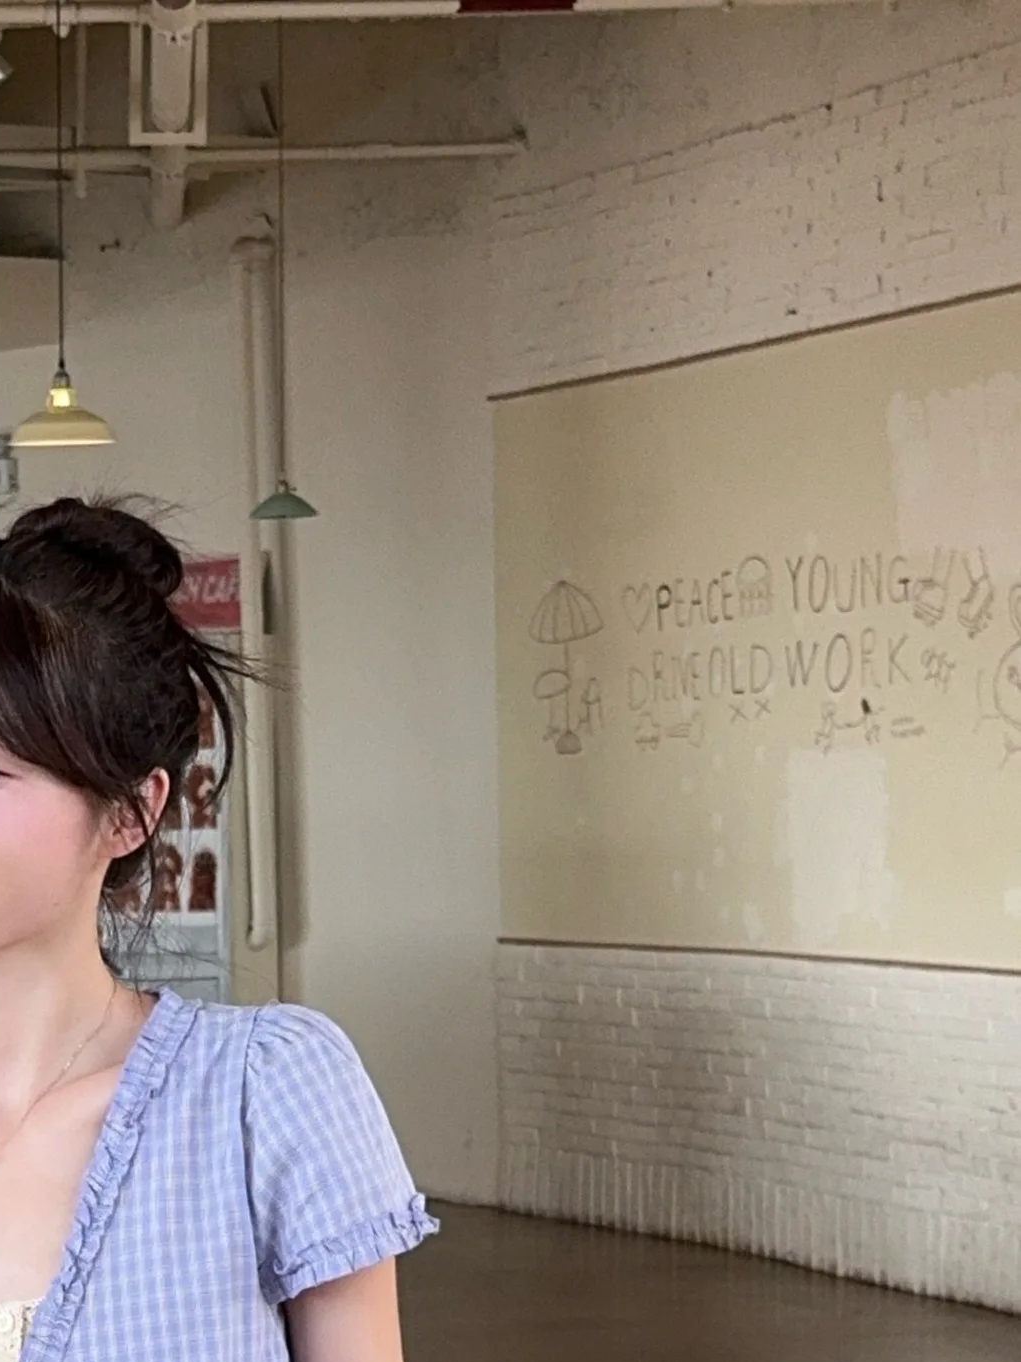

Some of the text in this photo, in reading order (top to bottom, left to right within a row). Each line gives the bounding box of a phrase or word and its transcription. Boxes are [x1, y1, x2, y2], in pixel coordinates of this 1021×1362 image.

[656, 553, 910, 631] PEACE YOUNG
[707, 642, 774, 699] OLD
[783, 626, 913, 694] WORK
